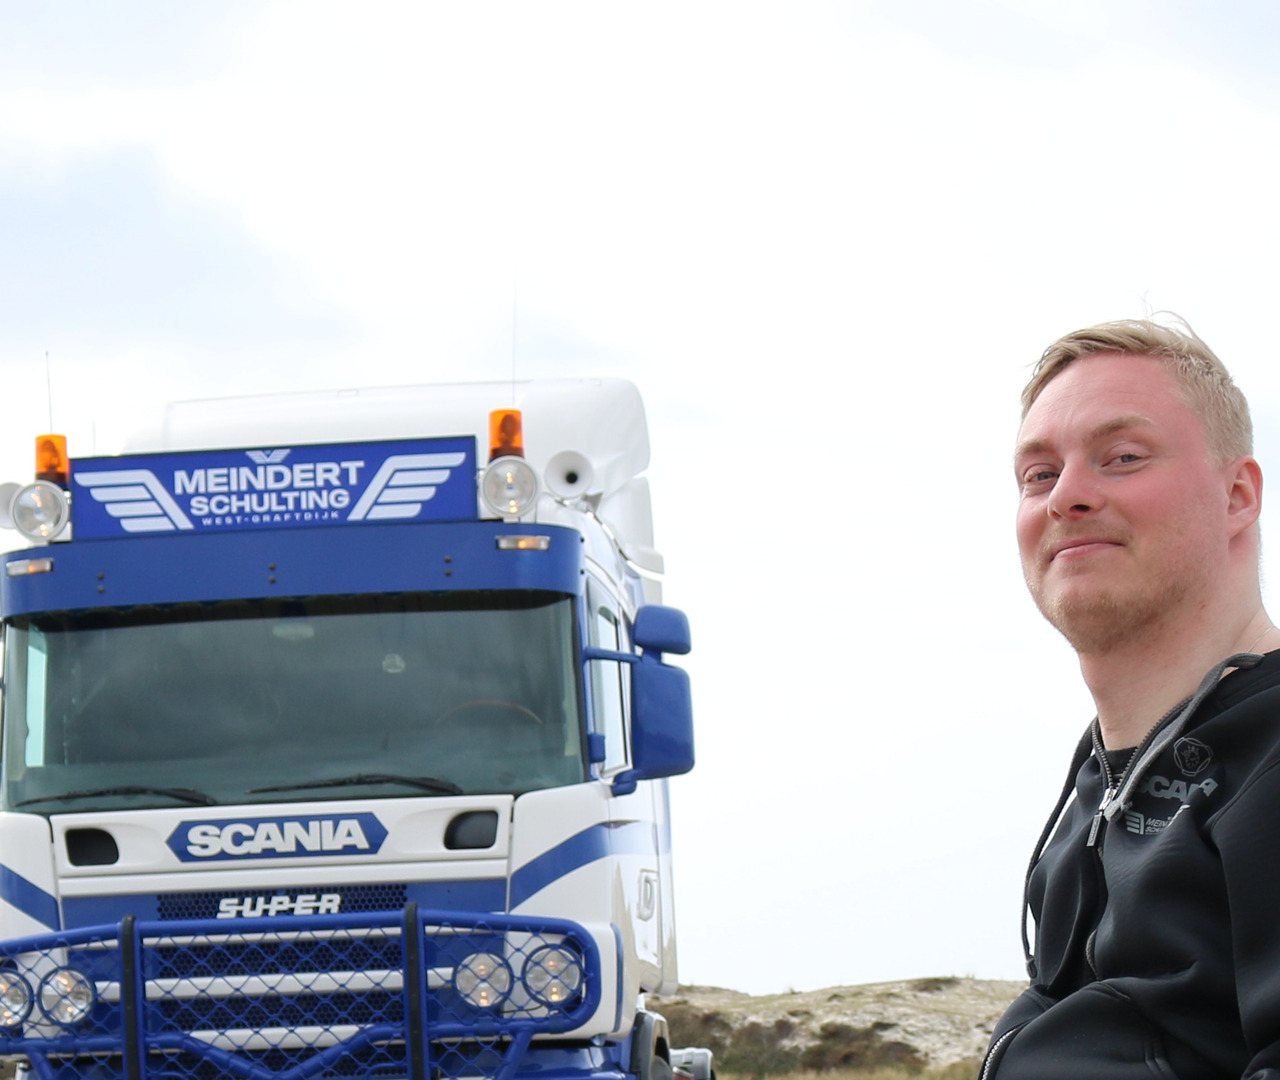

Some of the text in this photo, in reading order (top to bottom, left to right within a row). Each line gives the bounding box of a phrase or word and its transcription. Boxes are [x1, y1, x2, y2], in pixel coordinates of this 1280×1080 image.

[174, 460, 365, 495] MEINDERT
[190, 488, 350, 516] SCHULTING
[202, 510, 340, 526] WEST-GRAFTDIJK
[186, 819, 370, 857] SCANIA
[217, 893, 341, 919] SUPER
